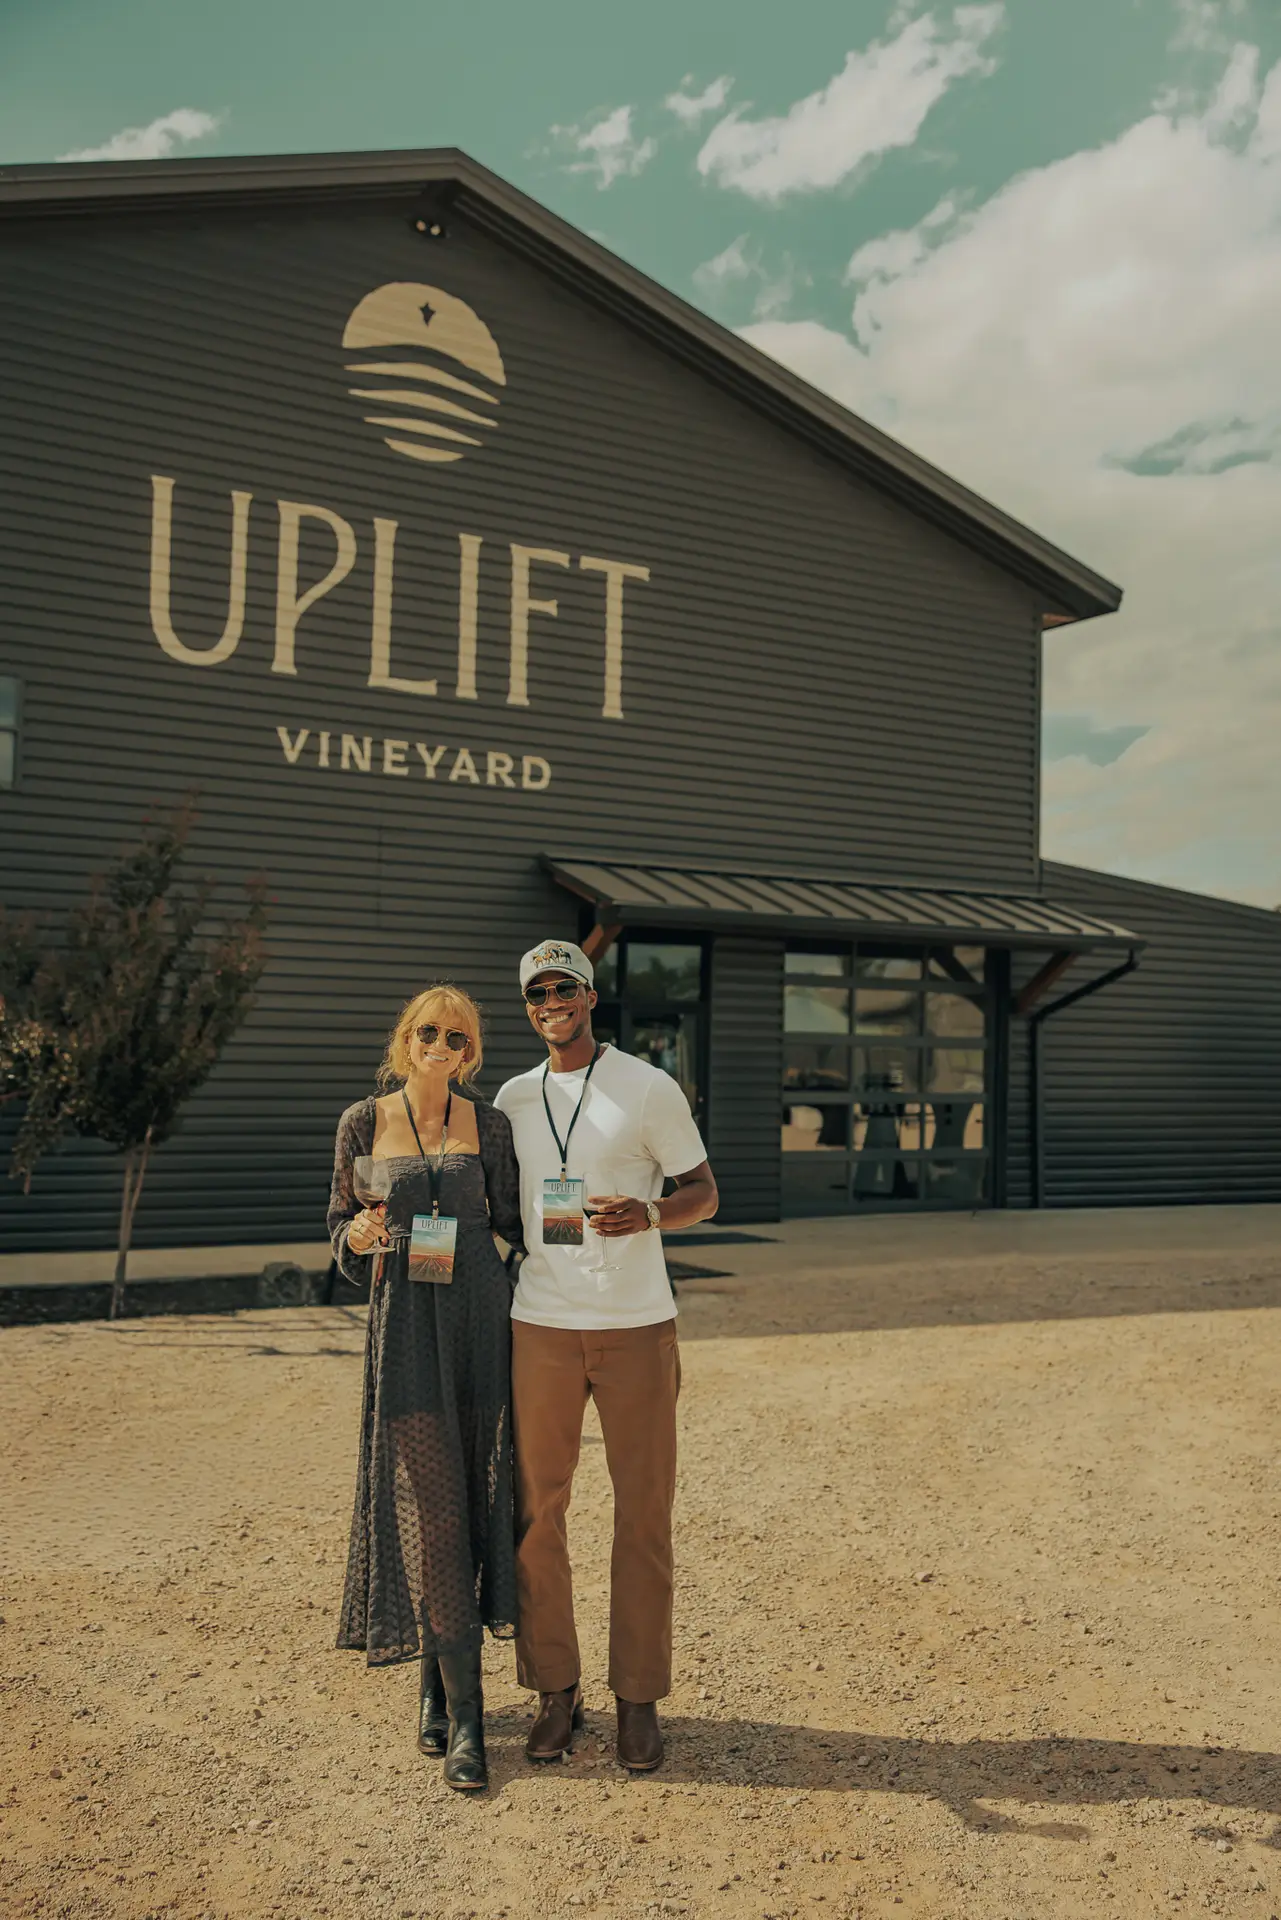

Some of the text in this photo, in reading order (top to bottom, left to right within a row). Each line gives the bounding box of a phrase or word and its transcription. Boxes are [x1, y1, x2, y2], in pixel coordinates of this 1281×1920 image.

[150, 474, 650, 719] UPLIFT
[276, 726, 551, 790] VINEYARD
[551, 1182, 577, 1193] UPLIFT
[421, 1219, 449, 1230] UPLIFT
